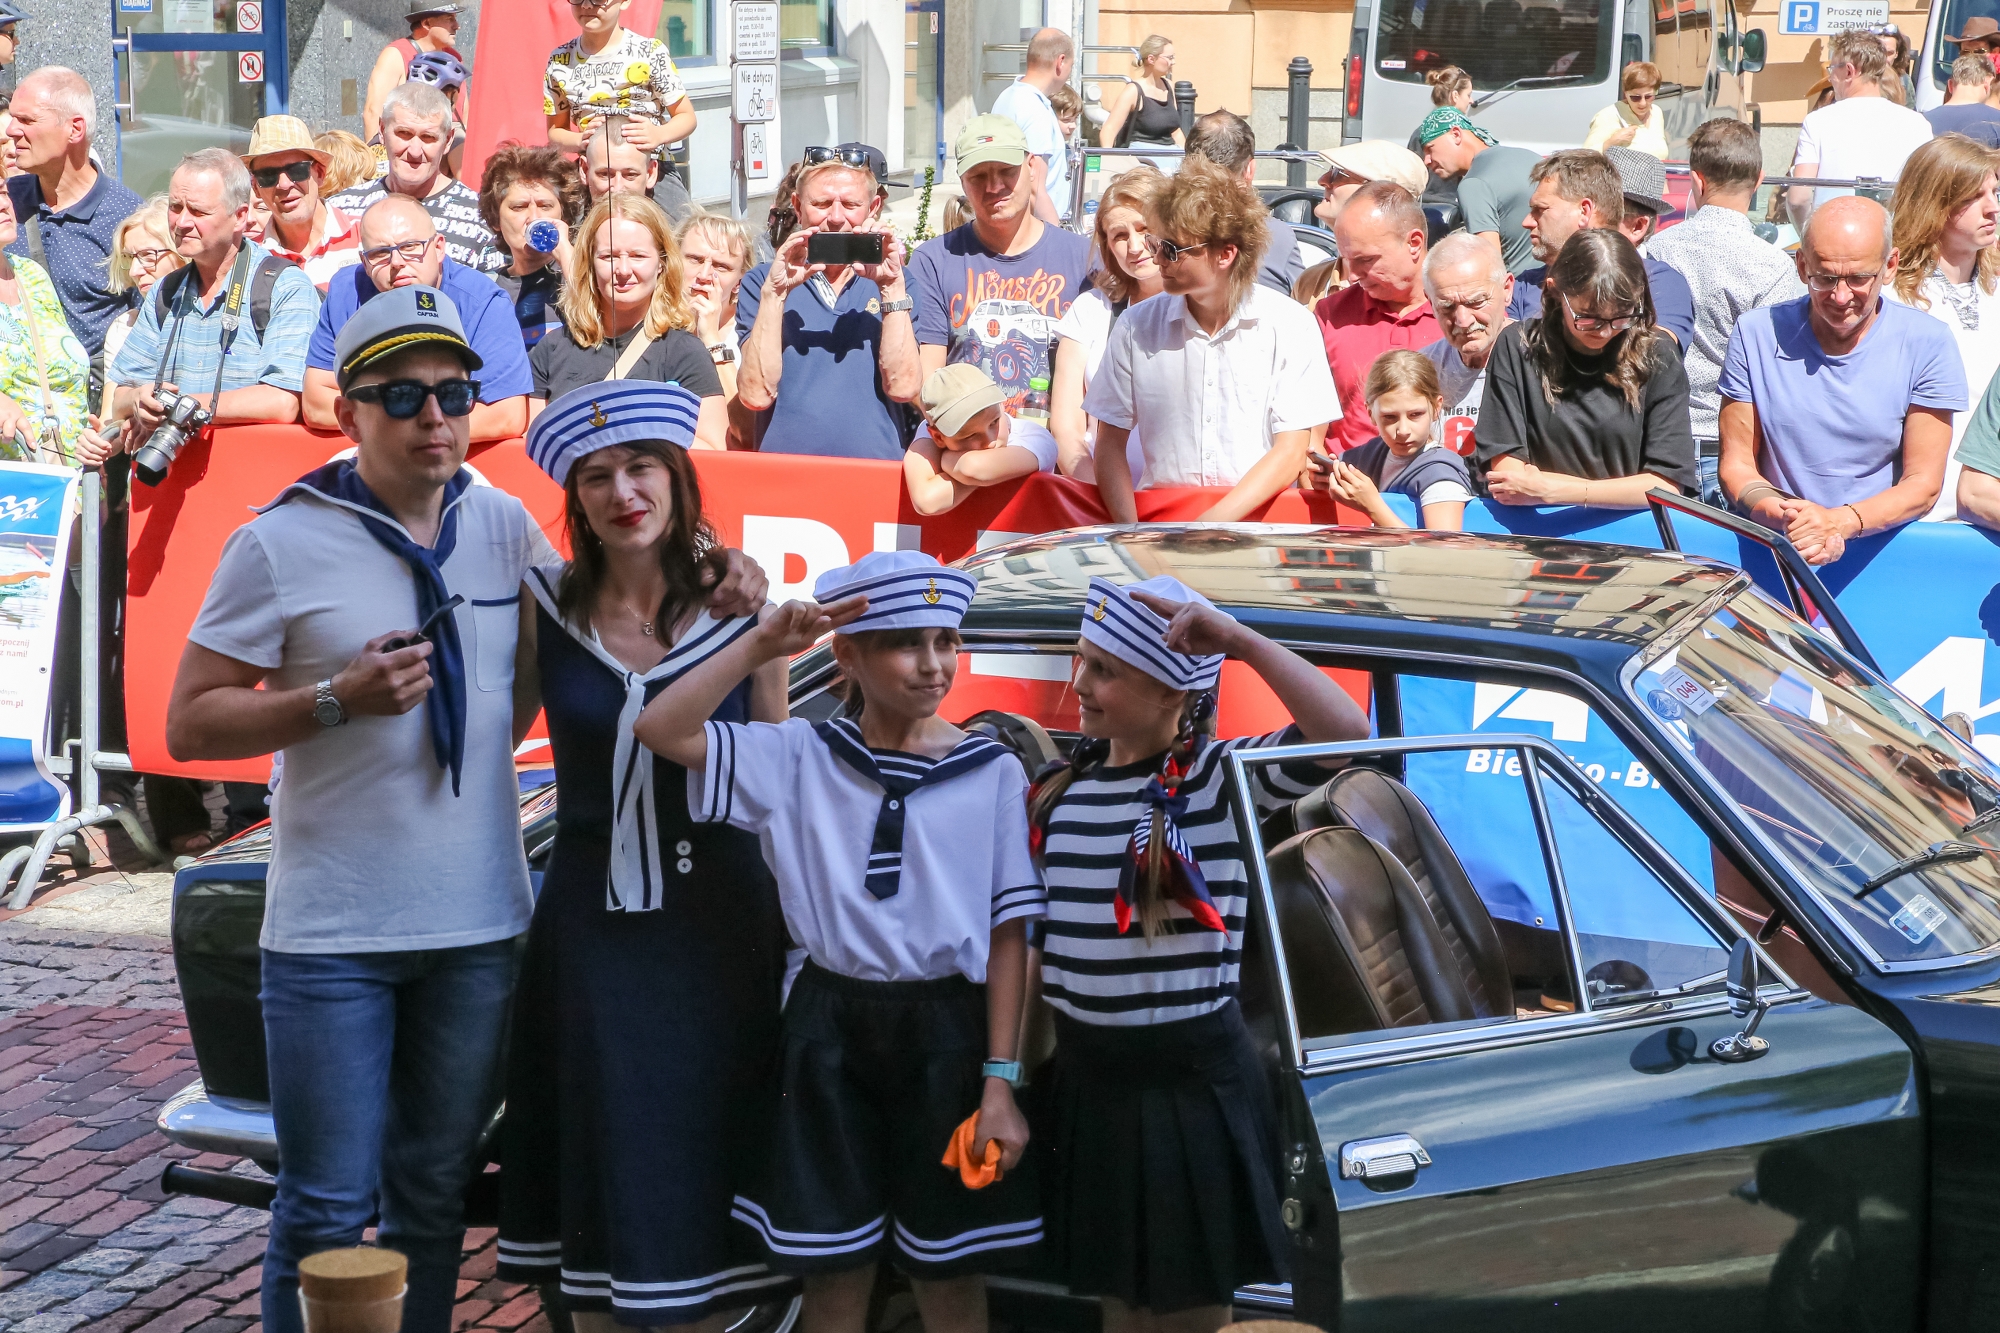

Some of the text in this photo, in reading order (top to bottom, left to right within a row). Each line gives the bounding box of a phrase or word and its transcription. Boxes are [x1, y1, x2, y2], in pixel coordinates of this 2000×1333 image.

[1827, 7, 1882, 17] Proszę nie
[741, 70, 773, 86] Nie dotyczy
[229, 282, 241, 310] Nikon
[1676, 681, 1698, 699] 049
